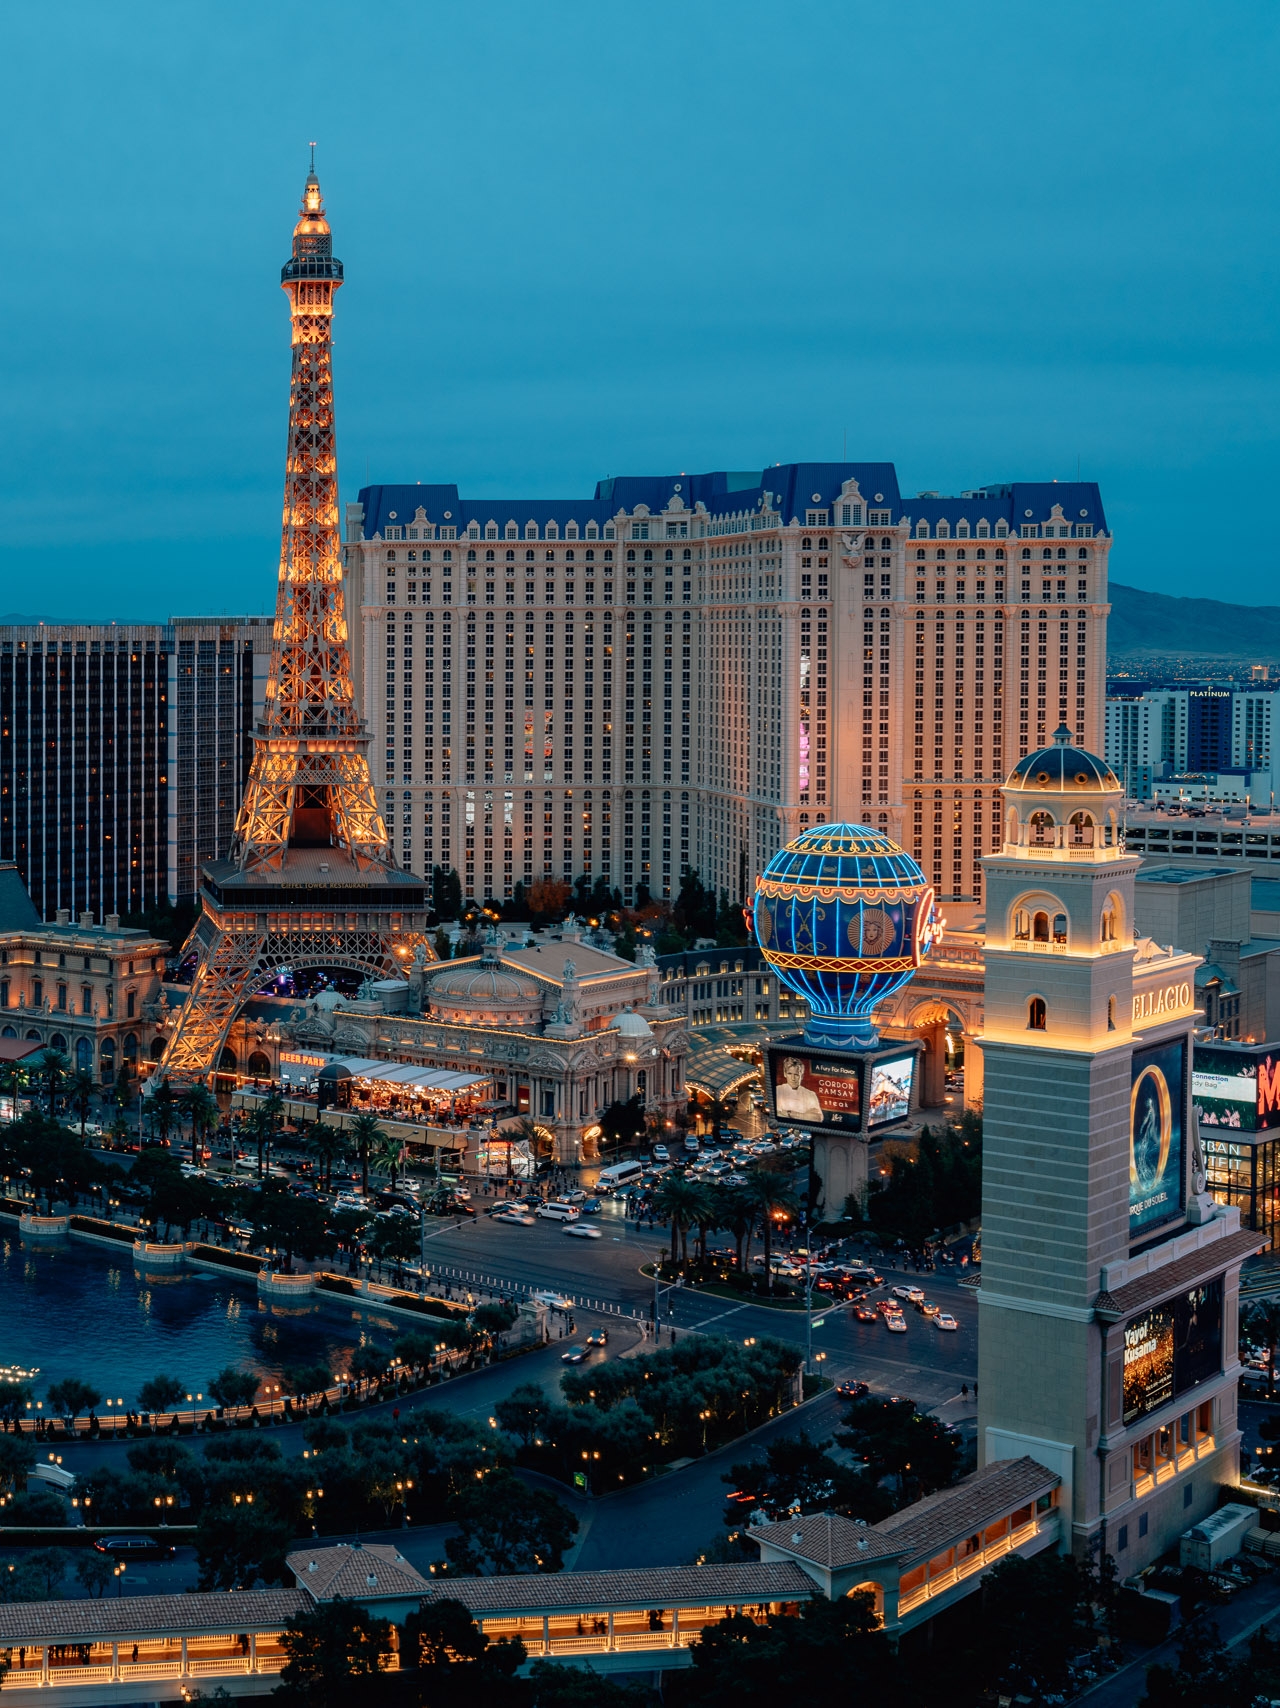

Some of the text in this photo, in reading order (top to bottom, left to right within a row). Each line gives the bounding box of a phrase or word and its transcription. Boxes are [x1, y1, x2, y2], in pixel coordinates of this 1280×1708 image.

[1190, 689, 1230, 698] PLATINUM
[1132, 982, 1190, 1020] ELLAGIO
[280, 1052, 325, 1067] BEER PARK
[1192, 1072, 1229, 1082] Connection
[818, 1080, 854, 1090] GORDON
[1192, 1080, 1218, 1089] ody Bag
[818, 1087, 854, 1098] RAMSAY
[1200, 1140, 1240, 1156] RBAN
[1205, 1169, 1223, 1182] RS
[1124, 1321, 1148, 1346] Yayoi
[1124, 1338, 1157, 1365] Kusama
